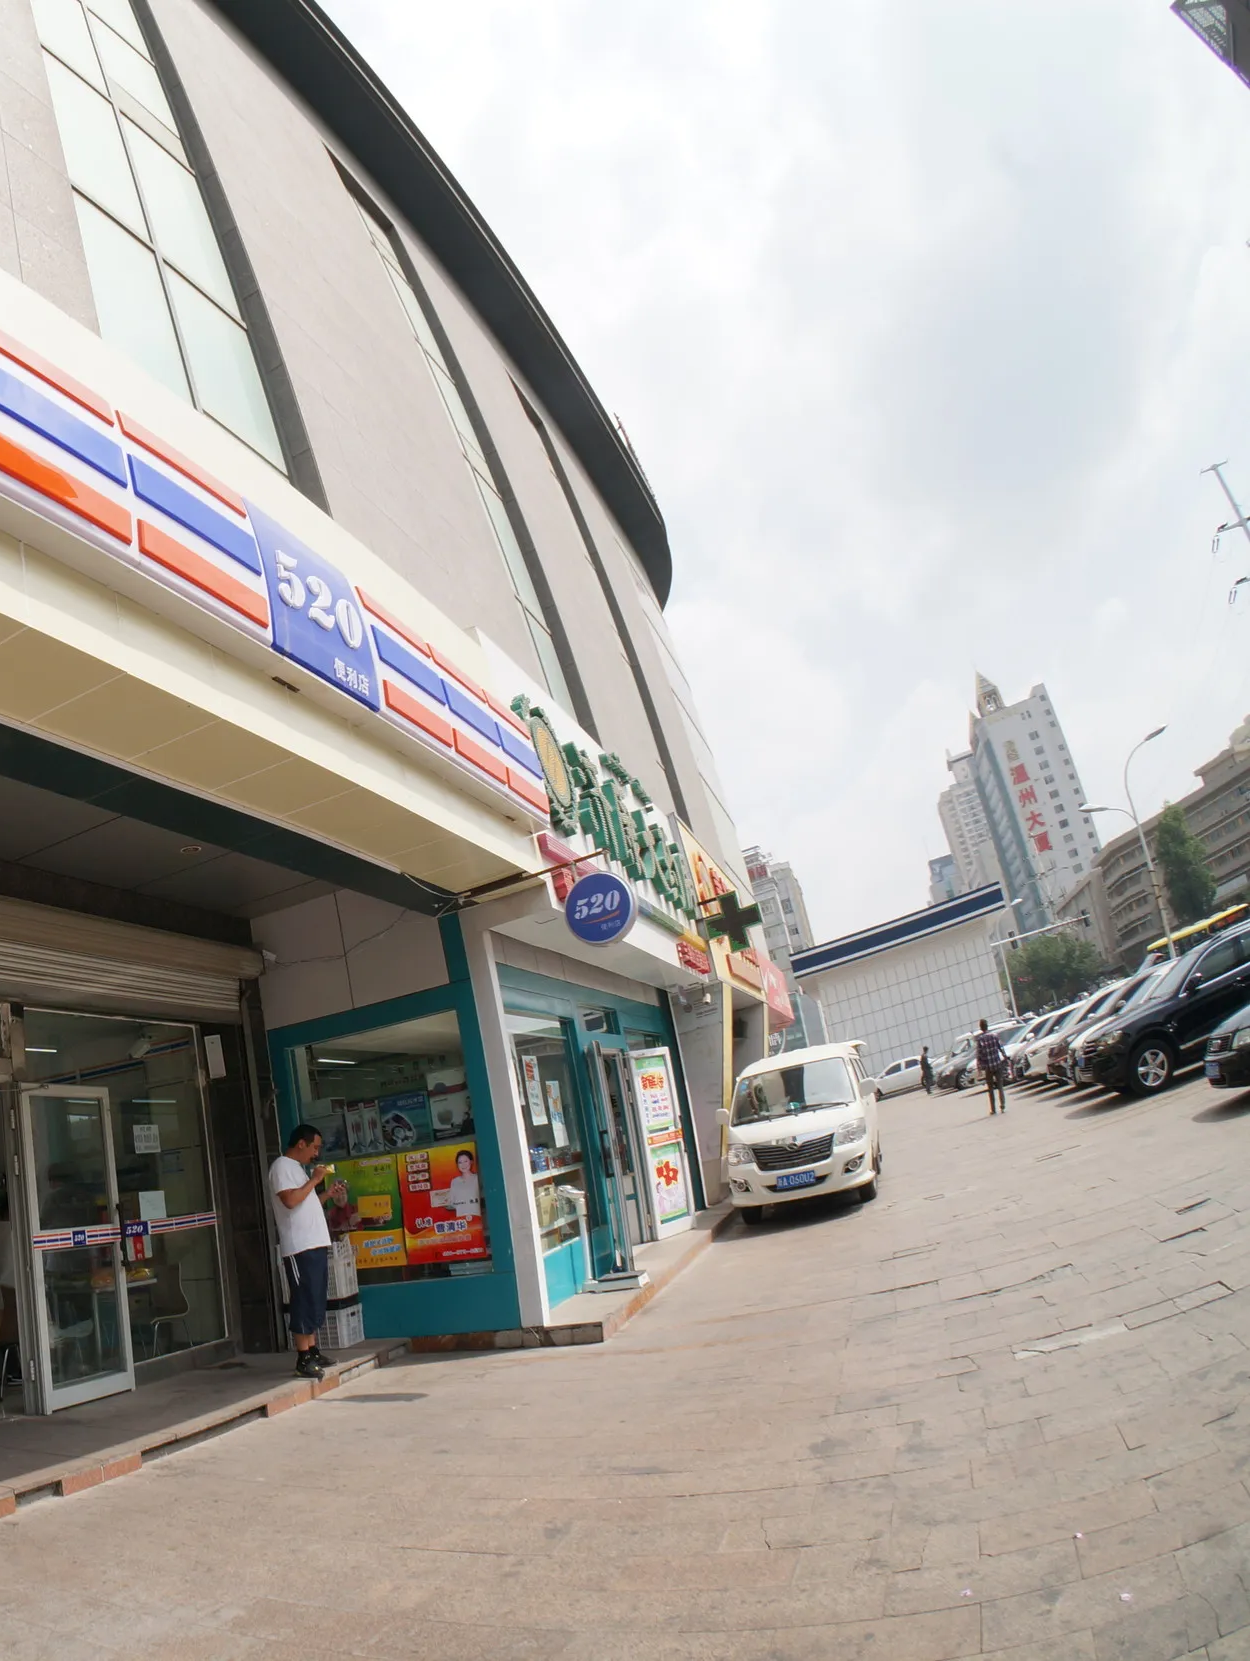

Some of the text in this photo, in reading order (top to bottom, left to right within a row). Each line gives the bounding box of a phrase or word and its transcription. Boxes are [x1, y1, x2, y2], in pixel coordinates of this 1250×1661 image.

[274, 548, 363, 650] 520
[333, 656, 370, 697] 便利店
[574, 889, 620, 922] 520
[126, 1225, 143, 1235] 520
